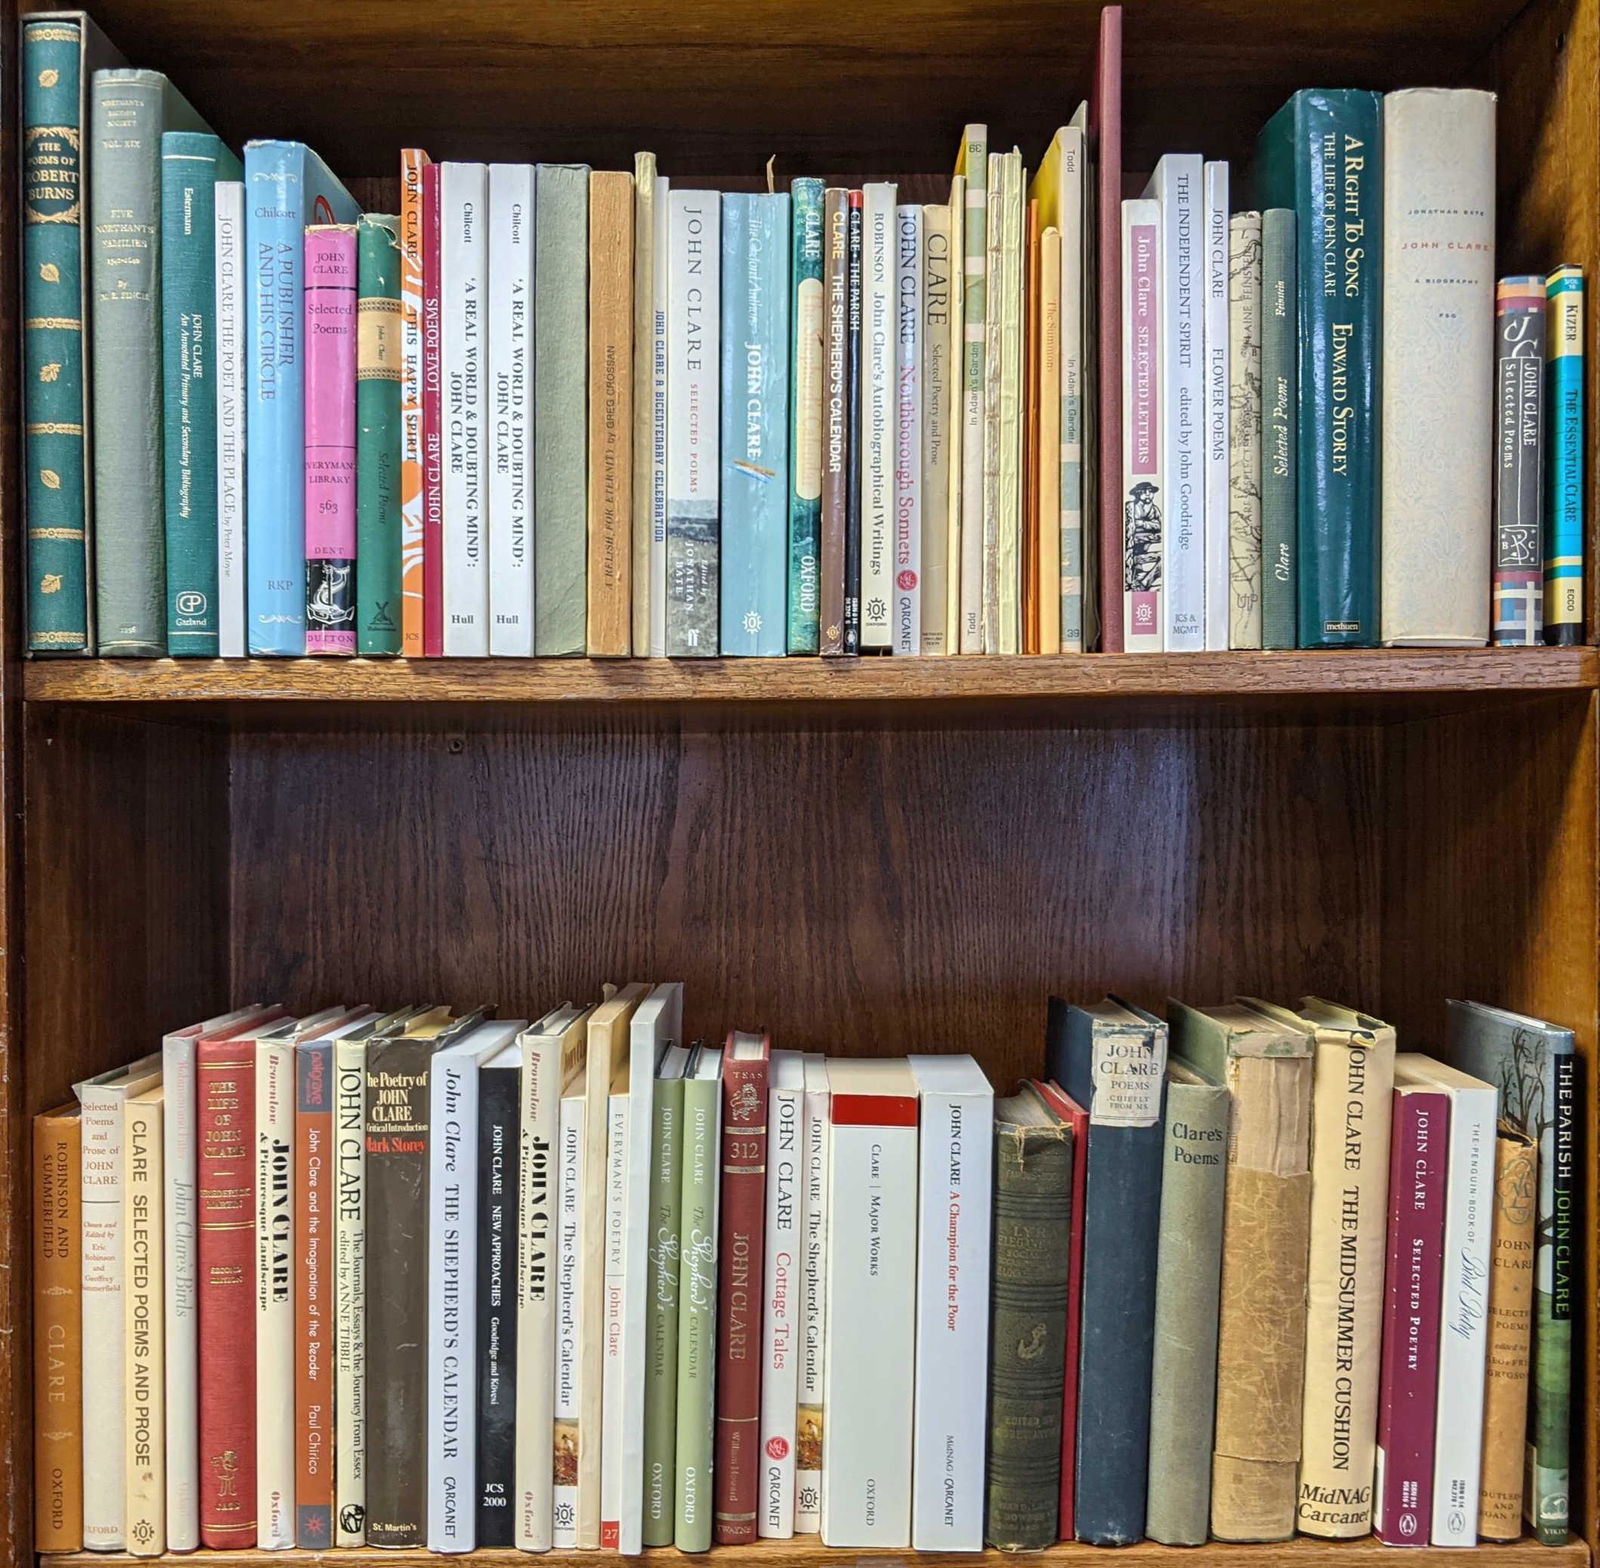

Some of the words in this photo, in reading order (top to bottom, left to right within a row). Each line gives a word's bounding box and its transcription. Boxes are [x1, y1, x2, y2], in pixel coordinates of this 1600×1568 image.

[38, 143, 61, 151] THE
[61, 156, 76, 165] OF
[1344, 134, 1364, 152] A
[407, 165, 417, 203] JOHN
[1178, 174, 1189, 204] THE
[183, 188, 194, 235] Estermann
[219, 215, 232, 257] JOHN
[278, 243, 293, 258] A
[407, 210, 417, 258] CLARE
[684, 206, 702, 276] JOHN
[833, 211, 844, 259] CLARE
[899, 214, 915, 268] JOHN
[258, 242, 274, 289] AND
[1178, 208, 1190, 318] INDEPENDENT
[220, 261, 234, 313] CLARE
[833, 274, 844, 301] THE
[181, 313, 190, 326] An
[192, 313, 202, 342] JOHN
[259, 293, 274, 326] HIS
[278, 262, 294, 365] PUBLISHER
[407, 311, 416, 345] THIS
[426, 299, 440, 348] POEMS
[512, 300, 523, 341] REAL
[687, 288, 702, 372] CLARE
[900, 276, 916, 344] CLARE
[1566, 305, 1578, 340] KIZER
[221, 316, 234, 347] THE
[830, 304, 843, 394] SHEPHERD'S
[1179, 322, 1190, 367] SPIRIT
[193, 345, 202, 378] CLARE
[221, 350, 234, 391] POET
[260, 330, 275, 400] CIRCLE
[407, 354, 416, 405] HAPPY
[427, 352, 439, 392] LOVE
[512, 347, 523, 405] WORLD
[179, 373, 190, 406] Primary
[222, 394, 235, 427] AND
[1180, 387, 1191, 428] edited
[1565, 389, 1578, 414] THE
[181, 408, 190, 422] and
[512, 410, 523, 422] &
[830, 399, 841, 472] CALENDAR
[897, 366, 916, 490] Northborough
[222, 430, 235, 463] THE
[406, 414, 417, 463] SPIRIT
[428, 434, 440, 485] CLARE
[1178, 431, 1192, 446] by
[512, 427, 524, 511] DOUBTING
[689, 453, 698, 493] POEMS
[1179, 450, 1192, 478] John
[222, 466, 236, 514] PLACE
[319, 500, 338, 514] 563
[428, 488, 440, 524] JOHN
[1564, 484, 1578, 522] CLARE
[899, 497, 914, 564] Sonnets
[1178, 484, 1192, 550] Goodridge
[497, 615, 518, 623] Hull
[901, 597, 911, 651] CARCANET
[380, 1072, 415, 1089] Poetry
[416, 1072, 428, 1086] of
[1346, 1040, 1366, 1094] JOHN
[1559, 1062, 1572, 1099] THE
[338, 1067, 361, 1129] JOHN
[376, 1090, 408, 1104] JOHN
[445, 1068, 460, 1114] John
[372, 1106, 412, 1122] CLARE
[778, 1096, 795, 1151] JOHN
[949, 1104, 961, 1139] JOHN
[1172, 1122, 1223, 1142] Clare's
[1416, 1110, 1429, 1153] JOHN
[132, 1121, 146, 1182] CLARE
[260, 1132, 268, 1142] &
[309, 1128, 320, 1152] John
[445, 1121, 460, 1172] Clare
[492, 1125, 502, 1154] JOHN
[731, 1143, 758, 1159] 312
[1174, 1146, 1219, 1165] Poems
[1345, 1101, 1363, 1170] CLARE
[1558, 1105, 1572, 1178] PARISH
[58, 1142, 68, 1218] ROBINSON
[272, 1139, 290, 1208] JOHN
[309, 1157, 320, 1187] Clare
[341, 1139, 361, 1221] CLARE
[492, 1156, 502, 1194] CLARE
[950, 1141, 961, 1185] CLARE
[43, 1154, 54, 1258] SUMMERFIELD
[259, 1149, 269, 1233] Picturesque
[309, 1191, 320, 1212] and
[445, 1184, 458, 1221] THE
[777, 1162, 794, 1230] CLARE
[950, 1191, 960, 1199] A
[1414, 1160, 1428, 1210] CLARE
[309, 1217, 320, 1233] the
[492, 1206, 502, 1231] NEW
[1342, 1186, 1359, 1230] THE
[1554, 1188, 1570, 1240] JOHN
[58, 1226, 68, 1257] AND
[133, 1195, 147, 1288] SELECTED
[947, 1203, 959, 1261] Champion
[259, 1235, 269, 1311] Landscape
[273, 1214, 290, 1302] CLARE
[306, 1238, 320, 1300] Imagination
[491, 1234, 502, 1306] APPROACHES
[948, 1265, 958, 1281] for
[1411, 1239, 1424, 1309] SELECTED
[1556, 1245, 1569, 1313] CLARE
[444, 1229, 458, 1348] SHEPHERD'S
[774, 1253, 790, 1317] Cottage
[948, 1284, 958, 1301] the
[1336, 1234, 1358, 1370] MIDSUMMER
[134, 1294, 148, 1357] POEMS
[309, 1305, 319, 1316] of
[309, 1320, 319, 1336] the
[947, 1305, 957, 1331] Poor
[490, 1317, 500, 1359] Goodridge
[774, 1324, 789, 1369] Tales
[135, 1363, 149, 1401] AND
[309, 1342, 319, 1380] Reader
[491, 1361, 499, 1375] and
[309, 1406, 320, 1429] Paul
[444, 1356, 458, 1459] CALENDAR
[1333, 1377, 1352, 1470] CUSHION
[136, 1407, 149, 1465] PROSE
[309, 1433, 320, 1474] Chirico
[52, 1468, 63, 1529] OXFORD
[445, 1476, 456, 1538] CARCANET
[484, 1497, 506, 1506] 2000
[485, 1484, 503, 1492] JCS
[769, 1467, 781, 1528] CARCANET
[1300, 1484, 1370, 1505] MidNAG
[605, 1529, 619, 1539] 27
[1299, 1502, 1368, 1524] Carcanet
